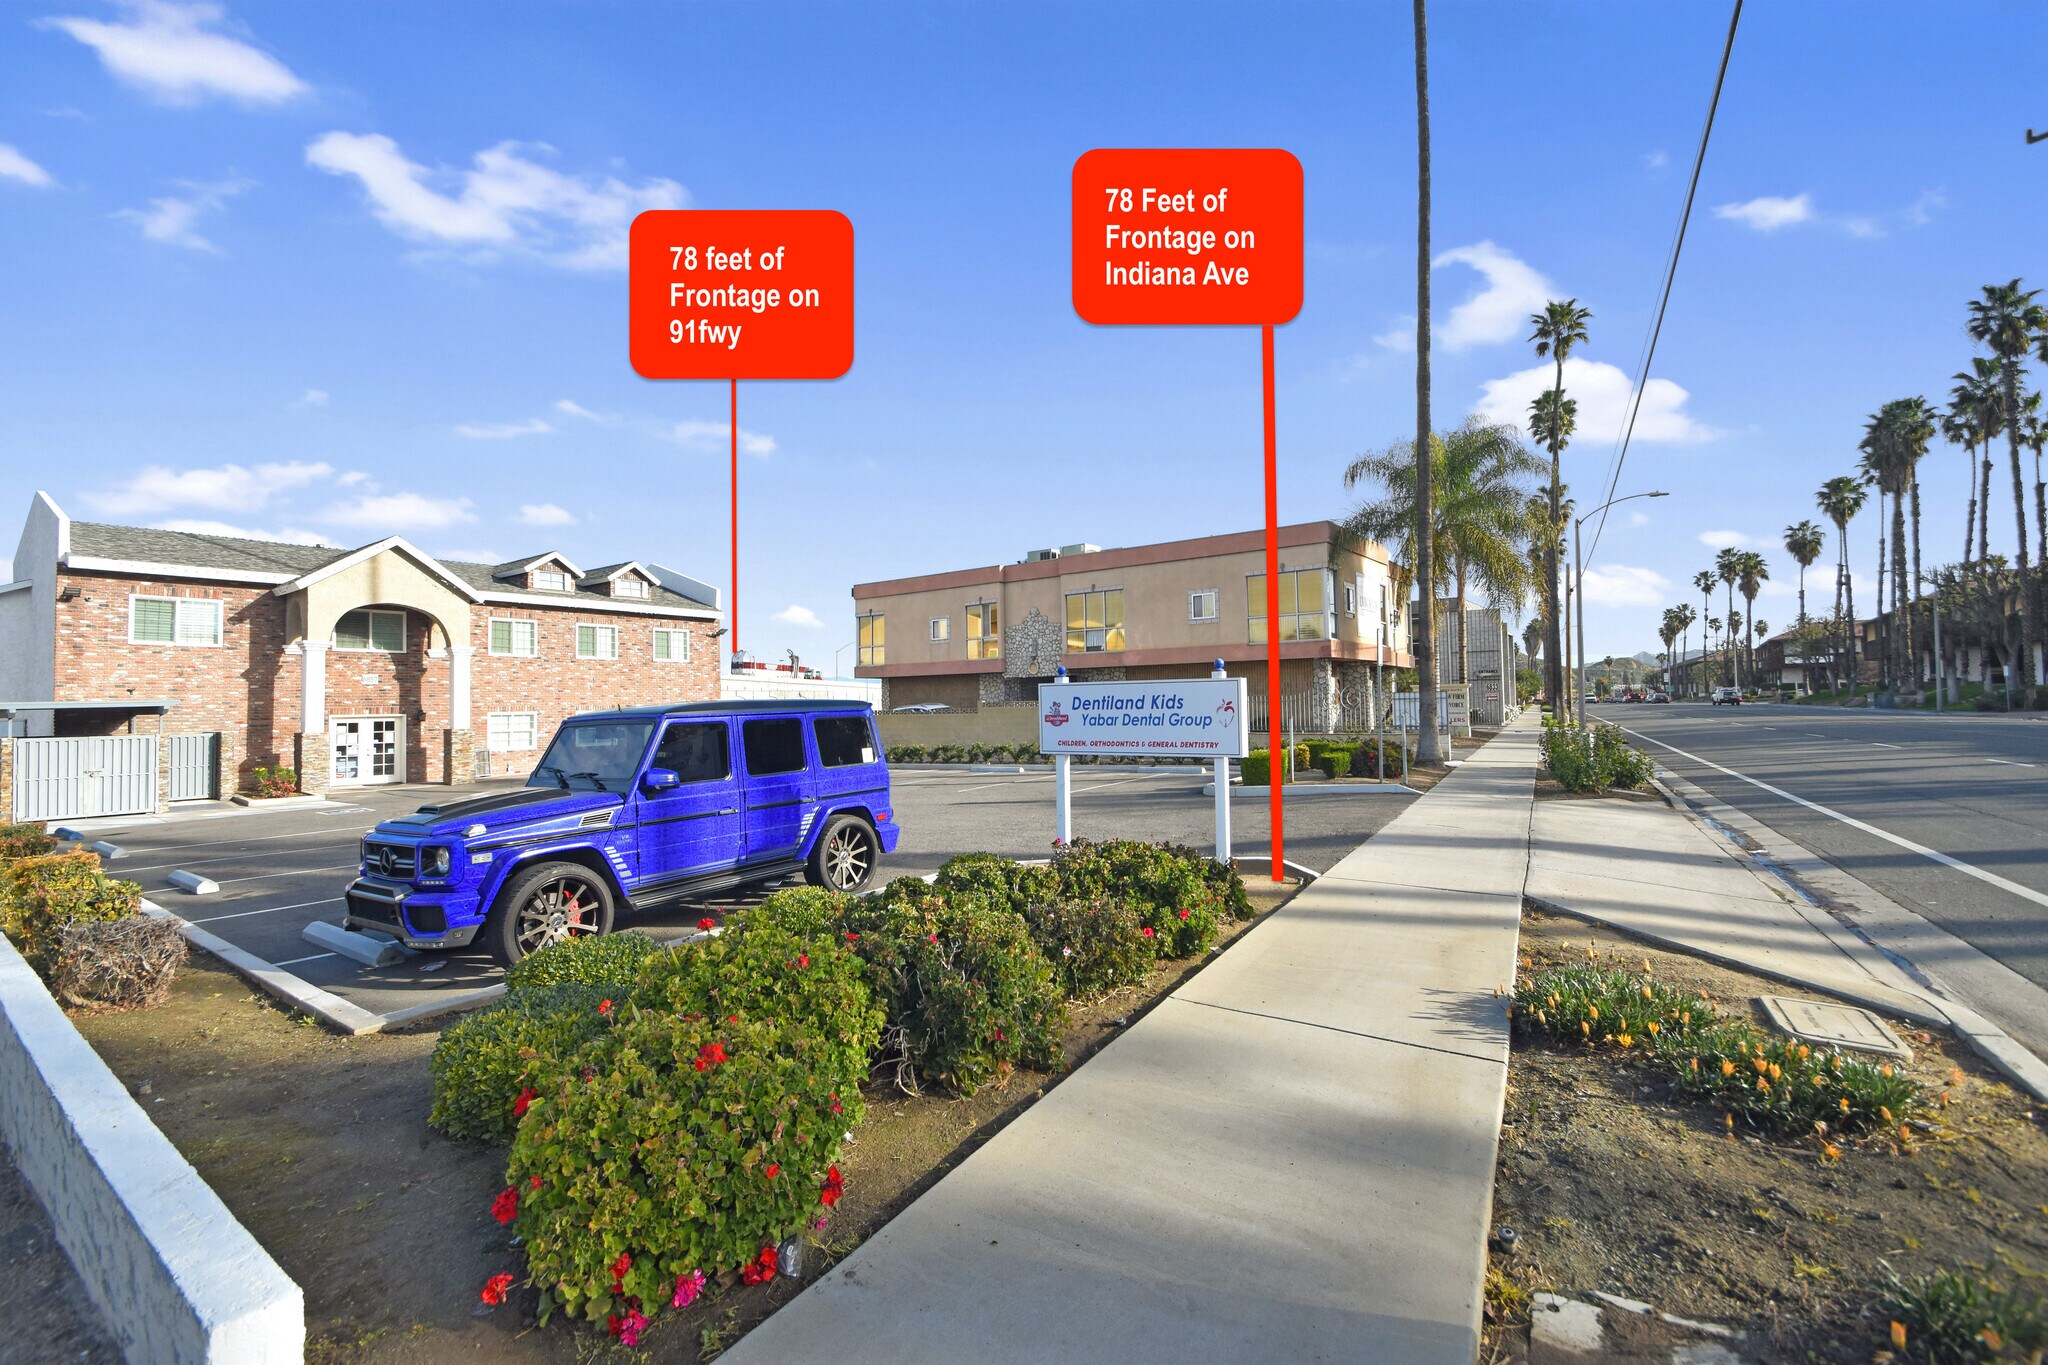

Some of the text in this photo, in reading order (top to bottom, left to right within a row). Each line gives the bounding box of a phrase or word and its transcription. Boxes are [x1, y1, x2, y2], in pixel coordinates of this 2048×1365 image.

[1072, 694, 1184, 711] Dentiland Kids
[1082, 713, 1213, 729] Yabar Dental Group
[1089, 740, 1140, 748] ORTHODONTICS
[1180, 741, 1219, 749] DENTISTRY
